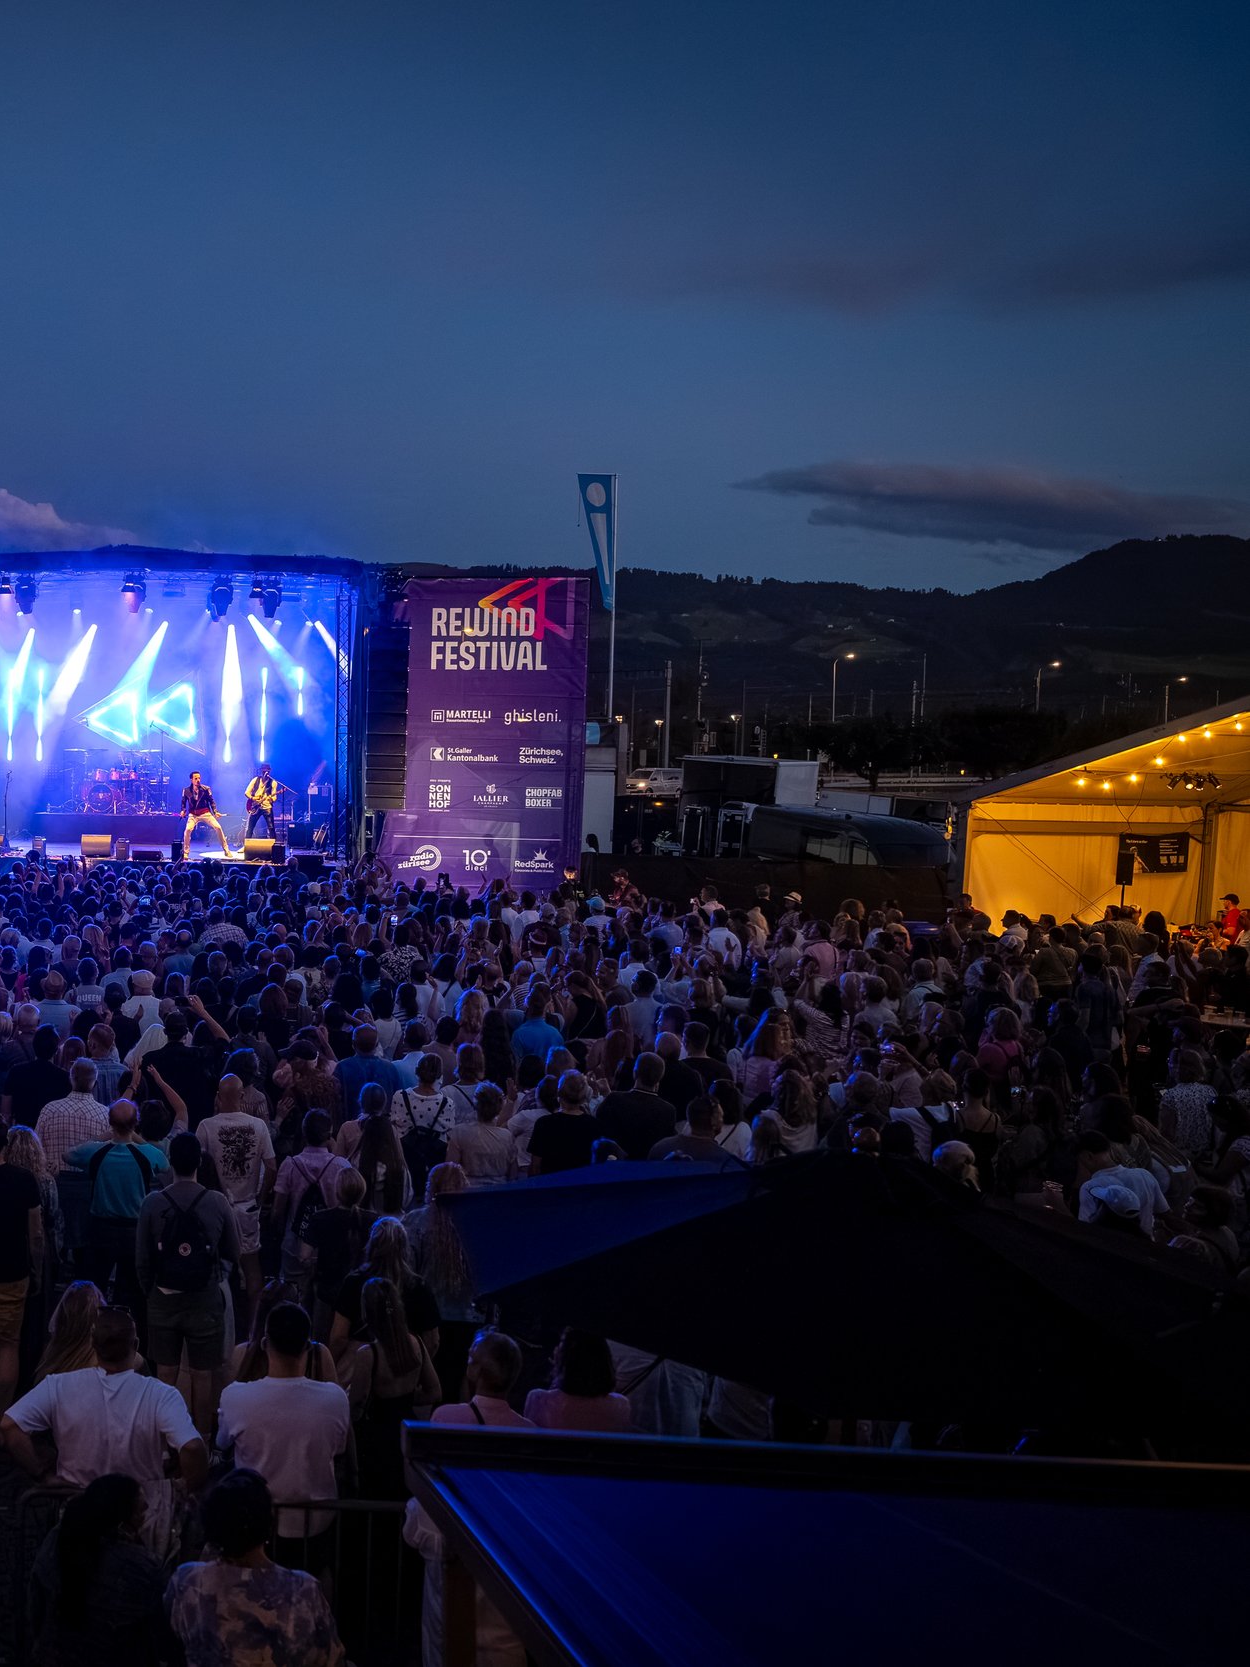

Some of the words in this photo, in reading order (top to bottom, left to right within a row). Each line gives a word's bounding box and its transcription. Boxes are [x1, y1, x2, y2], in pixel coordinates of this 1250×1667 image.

[431, 607, 536, 637] REWIND
[430, 641, 548, 671] FESTIVAL
[446, 710, 491, 719] MARTELLI
[504, 708, 562, 725] ghisleni.
[519, 746, 564, 757] Zürichsee,
[447, 754, 499, 762] Kantonalbank
[519, 756, 557, 764] Schweiz.
[429, 784, 451, 792] SON
[525, 788, 562, 797] CHOPFAB
[429, 792, 451, 800] NEN
[525, 798, 552, 807] BOXER
[410, 852, 434, 862] radio
[398, 859, 430, 869] zürisee
[465, 864, 488, 872] dieci
[514, 860, 554, 869] RedSpark
